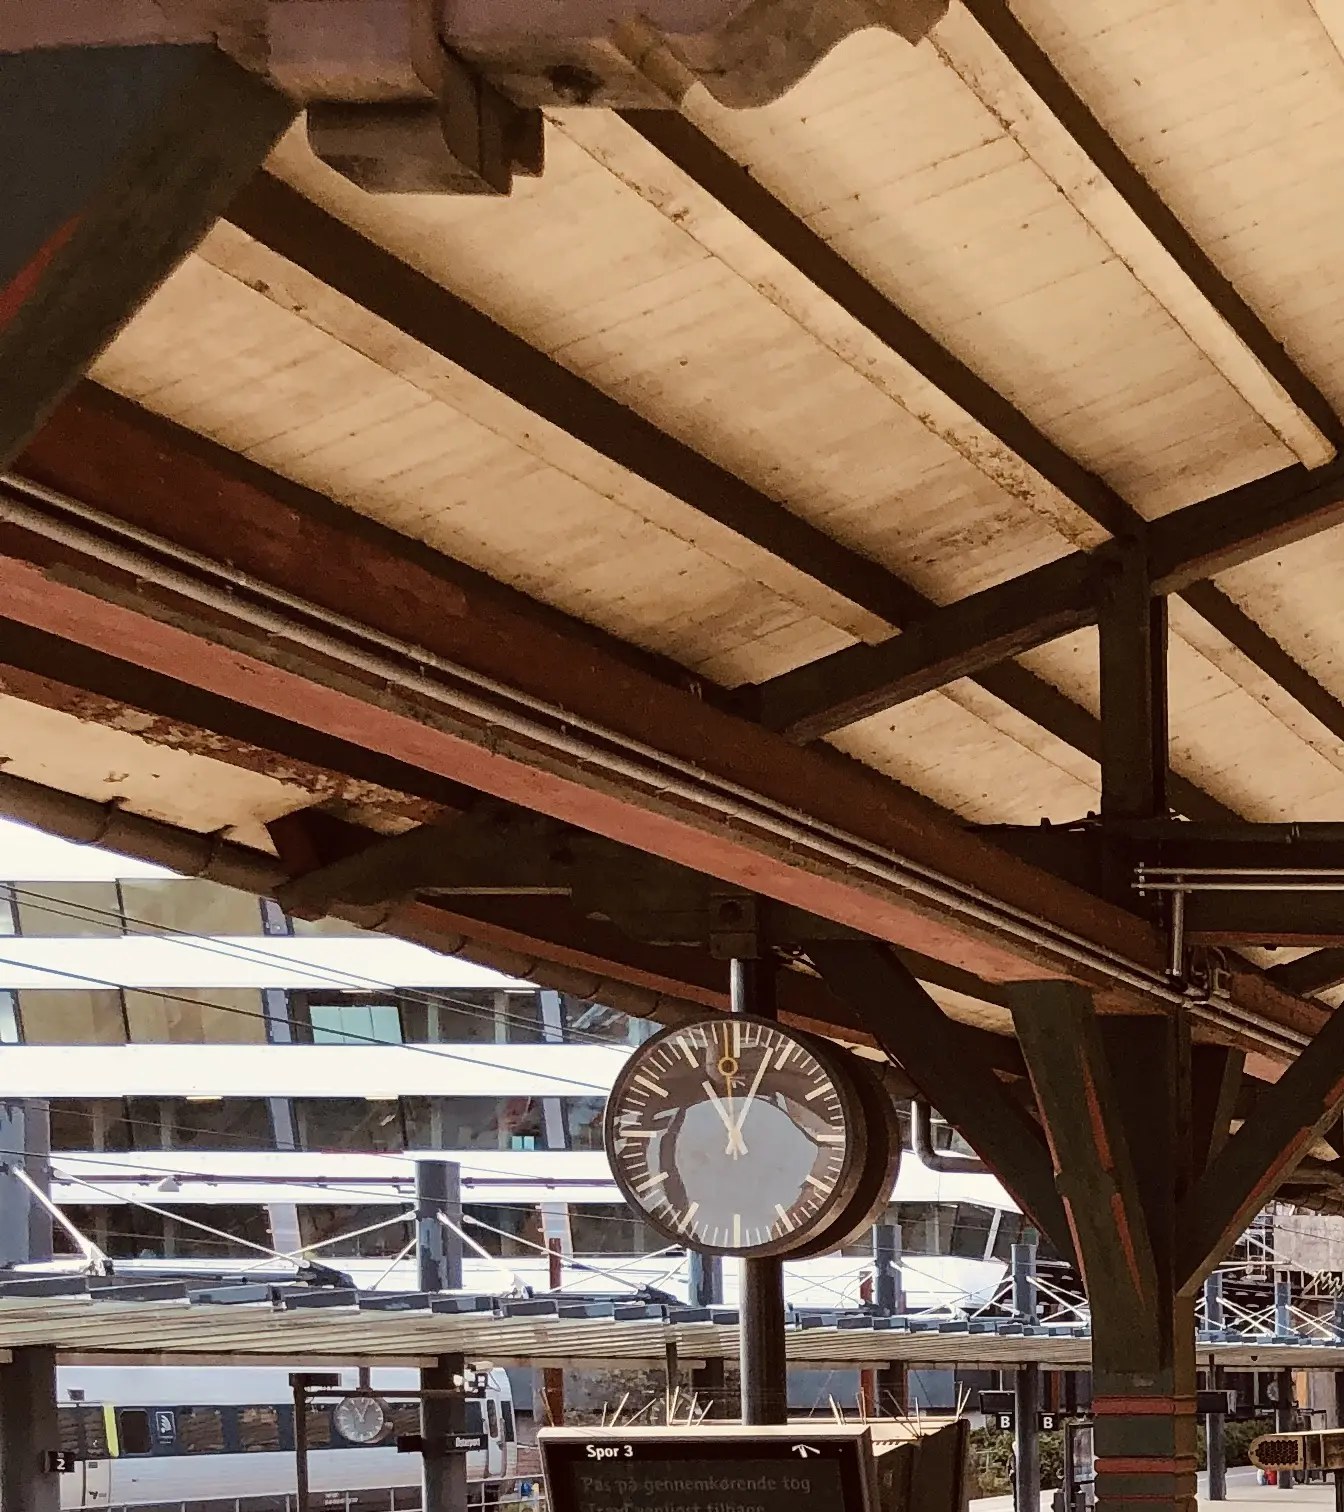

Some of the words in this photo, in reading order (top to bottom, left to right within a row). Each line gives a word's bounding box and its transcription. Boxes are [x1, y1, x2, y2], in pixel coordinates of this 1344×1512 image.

[1000, 1416, 1011, 1428] B
[1043, 1416, 1053, 1429] B
[586, 1445, 619, 1460] Spor
[623, 1445, 634, 1458] 3
[56, 1458, 66, 1470] 2
[644, 1475, 777, 1495] gennemkørende
[783, 1475, 811, 1494] tog
